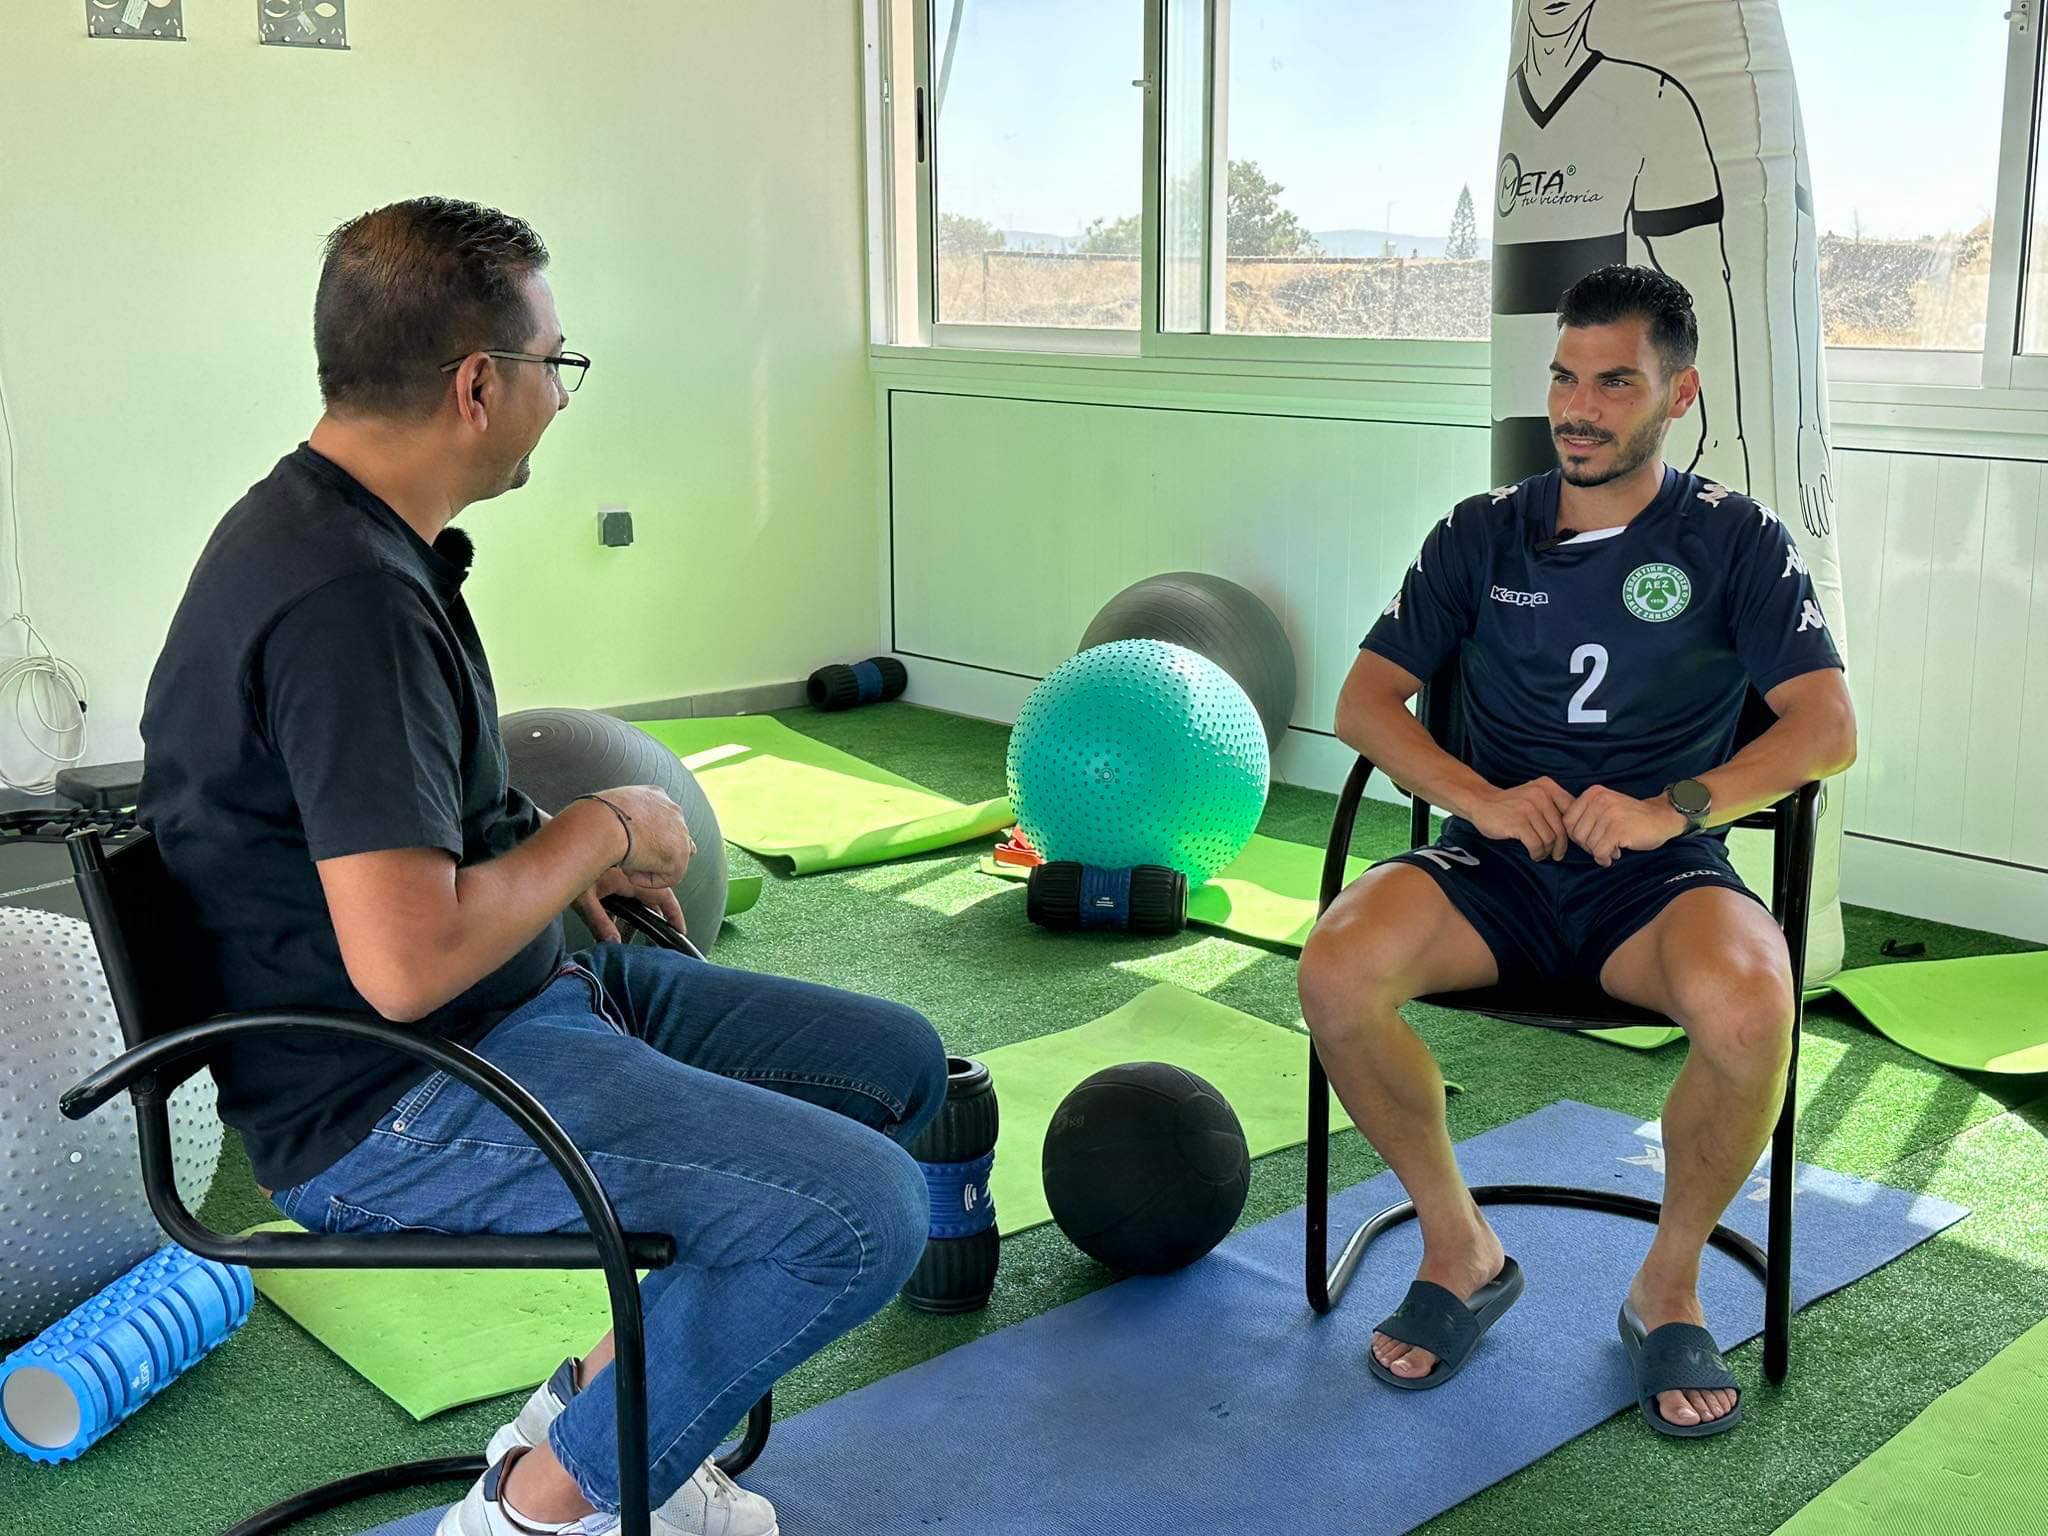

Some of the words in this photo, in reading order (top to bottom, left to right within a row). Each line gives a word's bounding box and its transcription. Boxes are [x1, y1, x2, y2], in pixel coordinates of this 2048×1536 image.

[1521, 195, 1538, 207] tu
[1540, 189, 1604, 205] victoria
[1490, 585, 1549, 607] Kapa
[1567, 643, 1609, 723] 2
